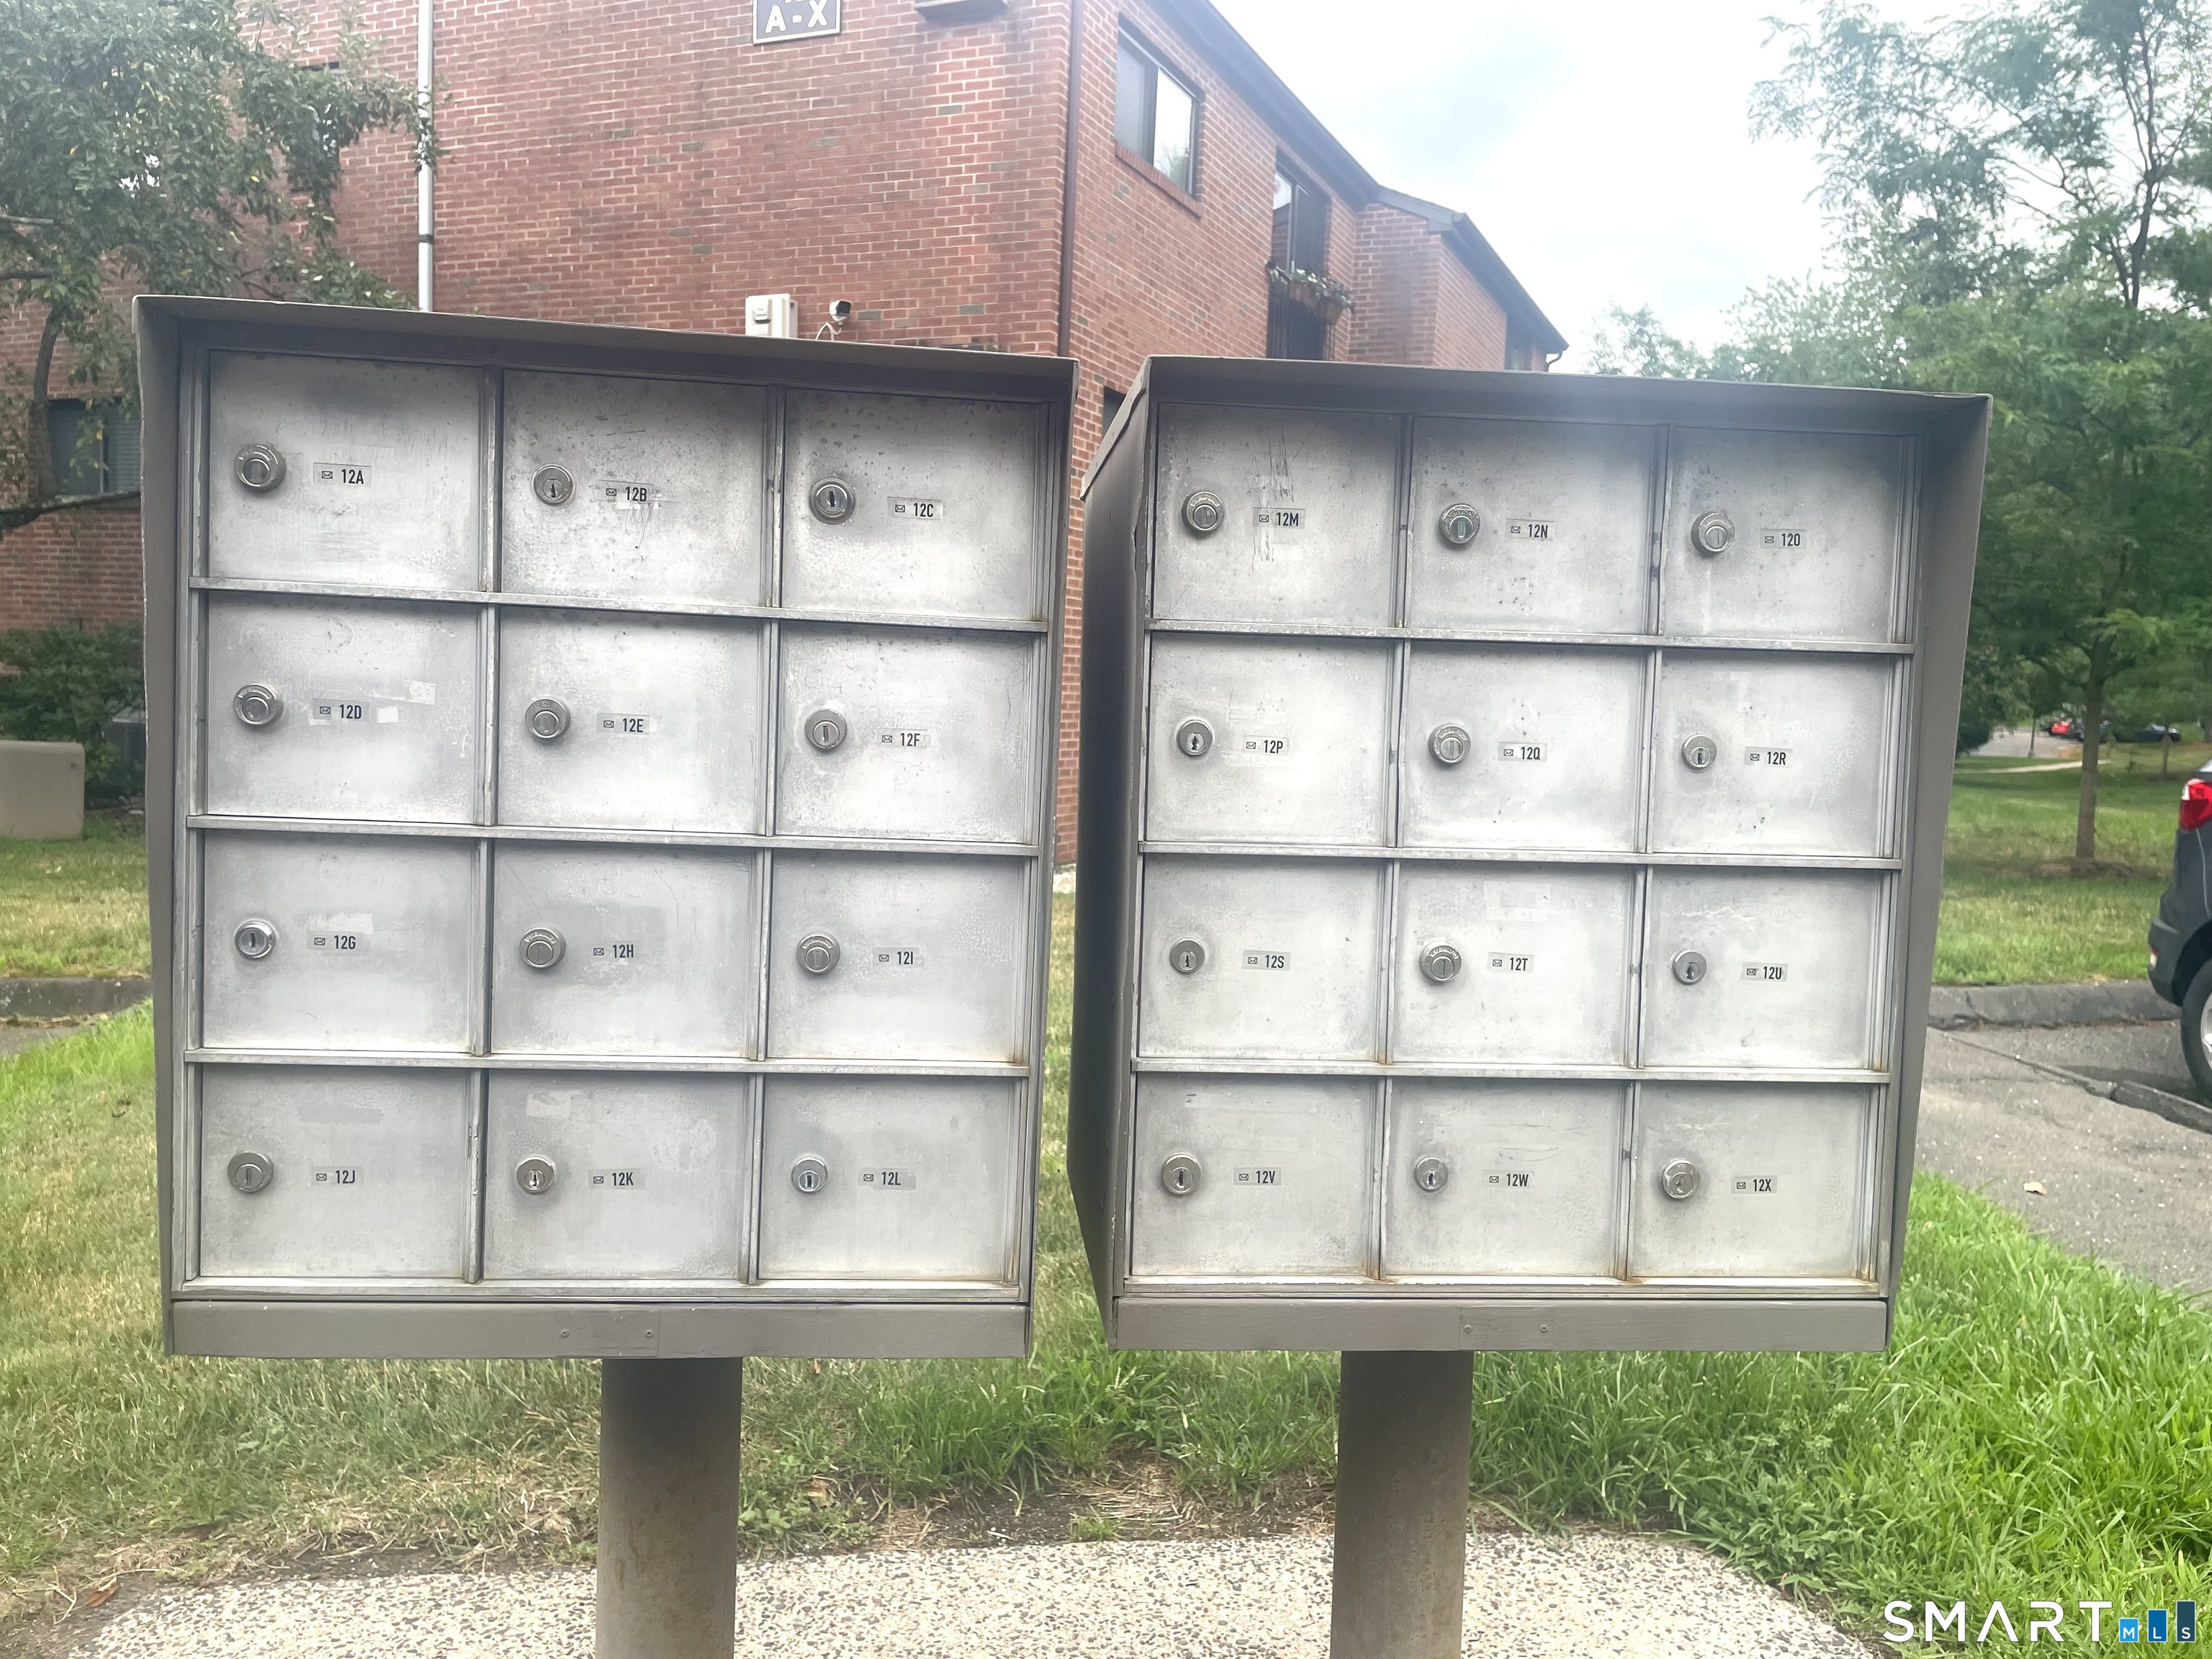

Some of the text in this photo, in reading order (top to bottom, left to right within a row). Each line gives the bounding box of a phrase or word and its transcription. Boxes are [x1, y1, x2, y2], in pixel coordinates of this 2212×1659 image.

[341, 469, 364, 485] 12A
[625, 486, 647, 502] 12B
[913, 503, 934, 518] 12C
[1276, 512, 1299, 527] 12M
[1528, 523, 1548, 539] 12N
[339, 704, 361, 719] 12D
[622, 718, 644, 733] 12E
[900, 732, 920, 747] 12F
[1264, 739, 1283, 754] 12P
[1521, 747, 1540, 760] 12Q
[1767, 751, 1786, 765] 12R
[334, 935, 356, 950] 12G
[612, 944, 634, 958] 12H
[1265, 955, 1285, 968] 12S
[1509, 957, 1529, 971] 12T
[1763, 966, 1782, 980] 12U
[335, 1169, 356, 1184] 12J
[611, 1172, 634, 1187] 12K
[881, 1172, 902, 1186] 12L
[1256, 1170, 1276, 1184] 12V
[1506, 1173, 1529, 1187] 12W
[1753, 1179, 1771, 1192] 12X
